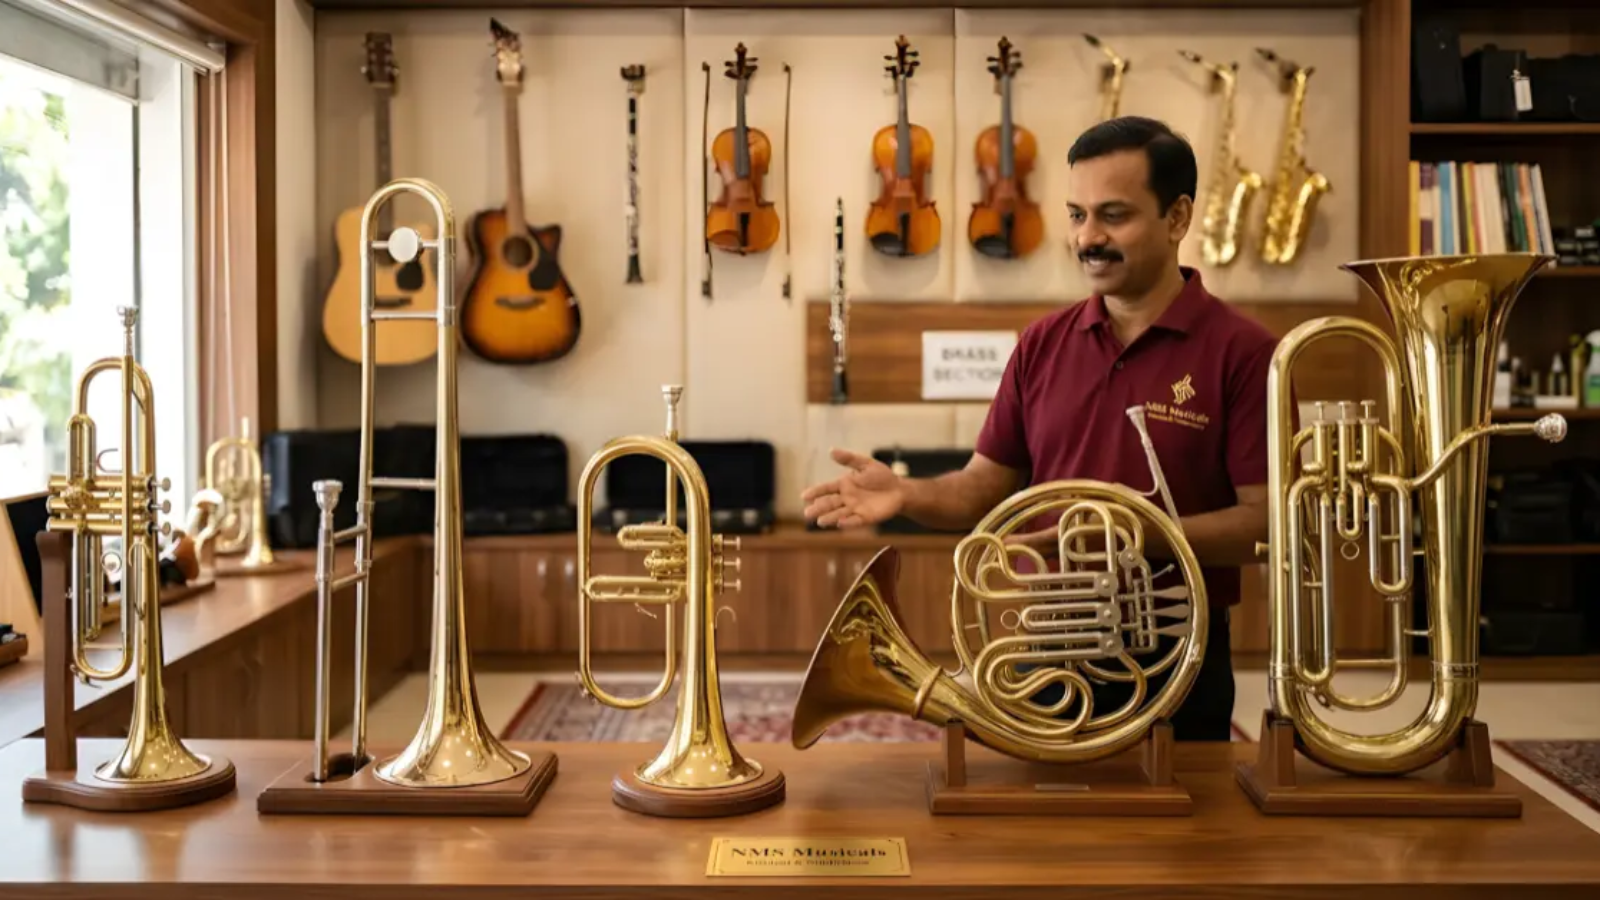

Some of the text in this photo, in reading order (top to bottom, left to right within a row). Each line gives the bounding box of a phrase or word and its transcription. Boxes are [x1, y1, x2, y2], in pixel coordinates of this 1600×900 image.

[941, 347, 998, 361] BRASS
[731, 847, 886, 858] NMS Musicals
